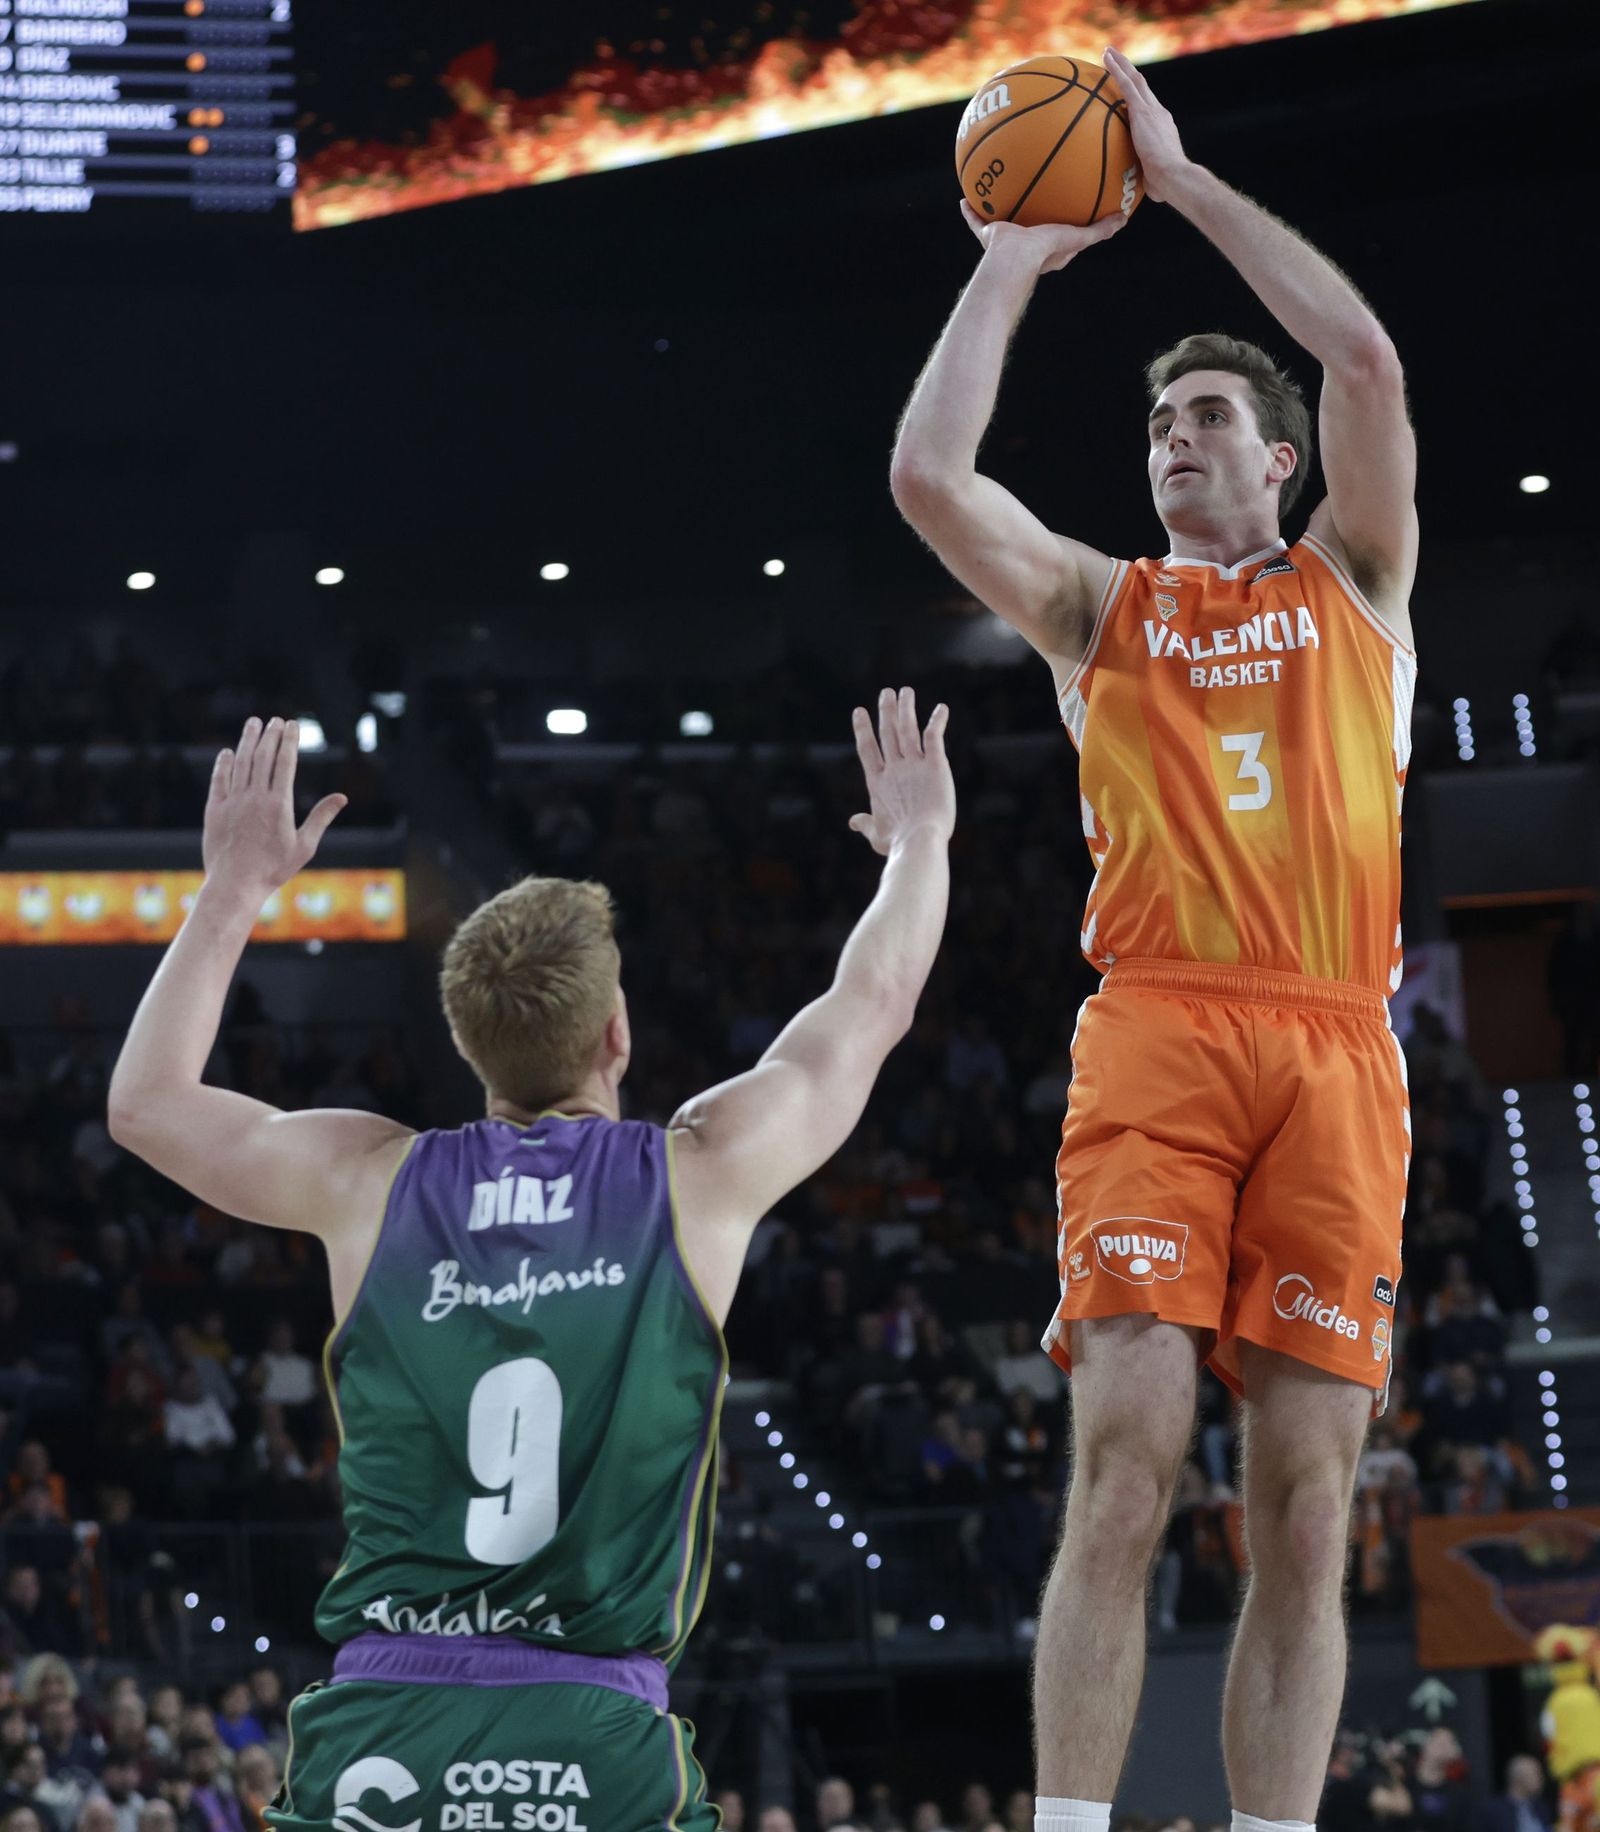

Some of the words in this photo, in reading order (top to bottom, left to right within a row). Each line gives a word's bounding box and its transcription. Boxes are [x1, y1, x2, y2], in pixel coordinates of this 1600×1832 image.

[975, 159, 1005, 197] acb
[1143, 606, 1320, 662] VALENCIA
[1189, 659, 1283, 689] BASKET
[1220, 731, 1273, 811] 3
[467, 1166, 575, 1232] DÍAZ
[1282, 1291, 1361, 1340] Midea
[464, 1357, 564, 1566] 9
[443, 1759, 591, 1799] COSTA
[440, 1802, 505, 1832] DEL
[511, 1802, 588, 1832] SOL
